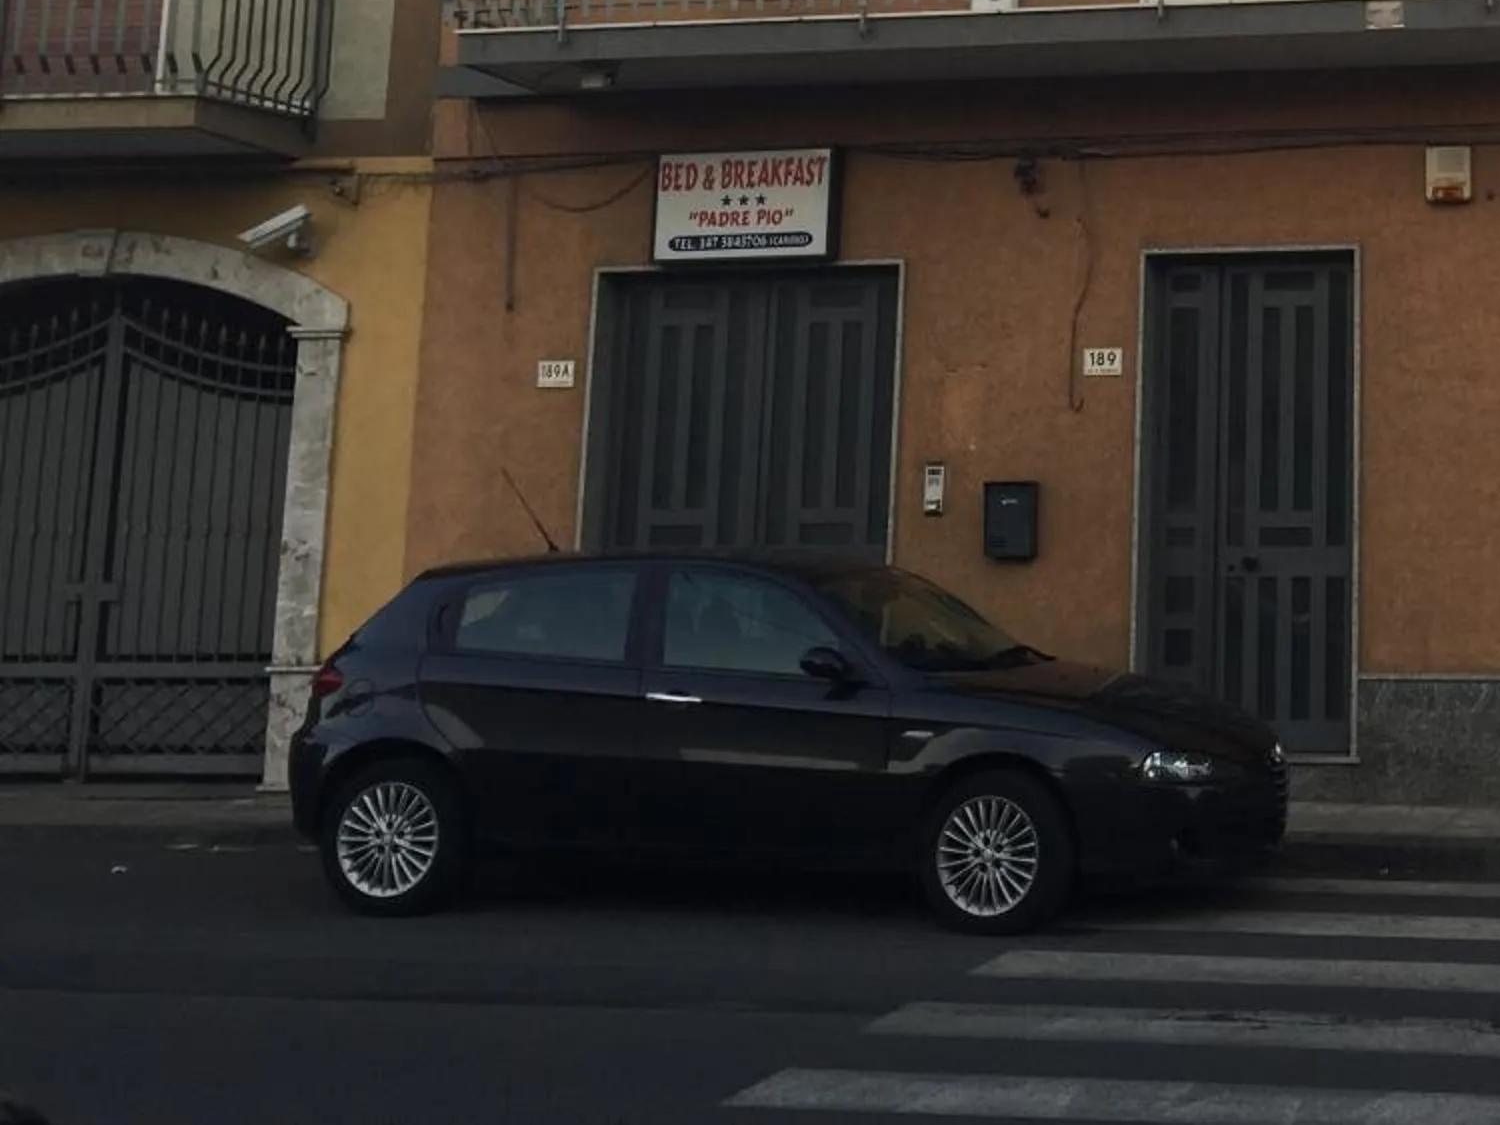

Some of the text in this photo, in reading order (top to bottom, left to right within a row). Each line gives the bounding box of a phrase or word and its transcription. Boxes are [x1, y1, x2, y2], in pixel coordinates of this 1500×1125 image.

[661, 156, 828, 191] BED & BREAKFAST
[1090, 351, 1117, 366] 189
